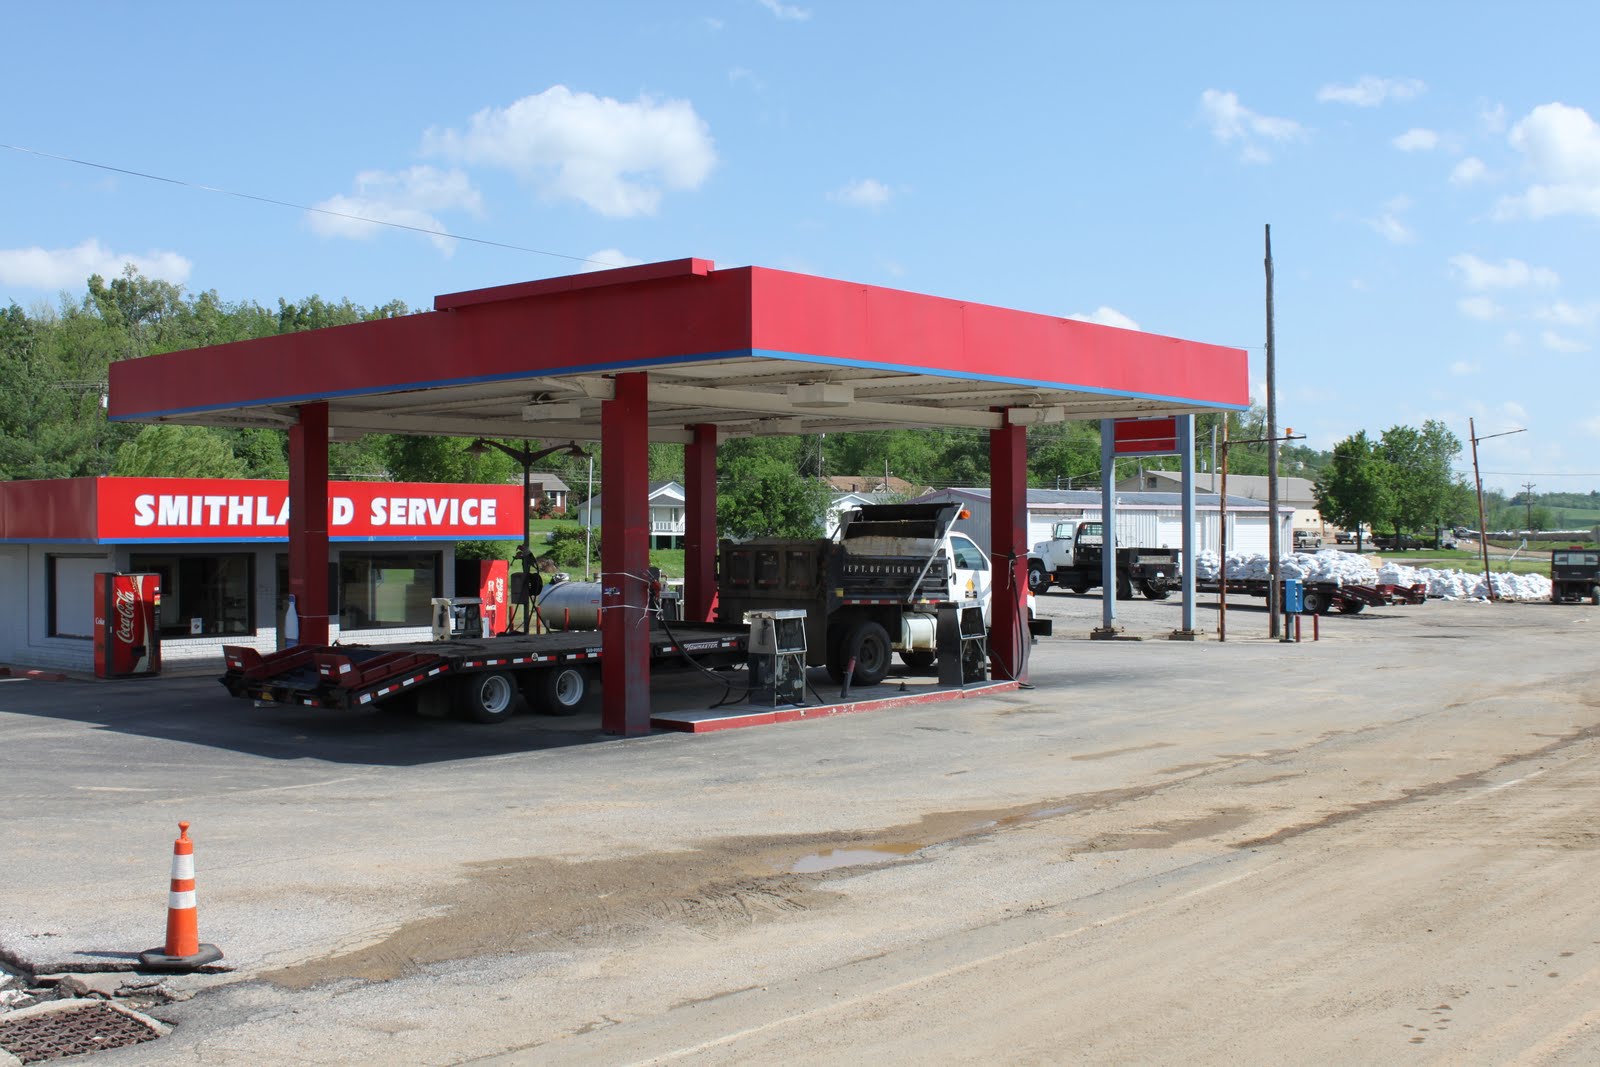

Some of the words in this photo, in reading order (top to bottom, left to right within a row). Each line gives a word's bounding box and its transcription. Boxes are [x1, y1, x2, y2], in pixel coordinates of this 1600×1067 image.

[134, 494, 355, 526] SMITHLAD
[370, 497, 496, 526] SERVICE
[869, 565, 880, 573] OF
[885, 565, 933, 574] HIGHWAS
[116, 587, 134, 643] Coca-Cola
